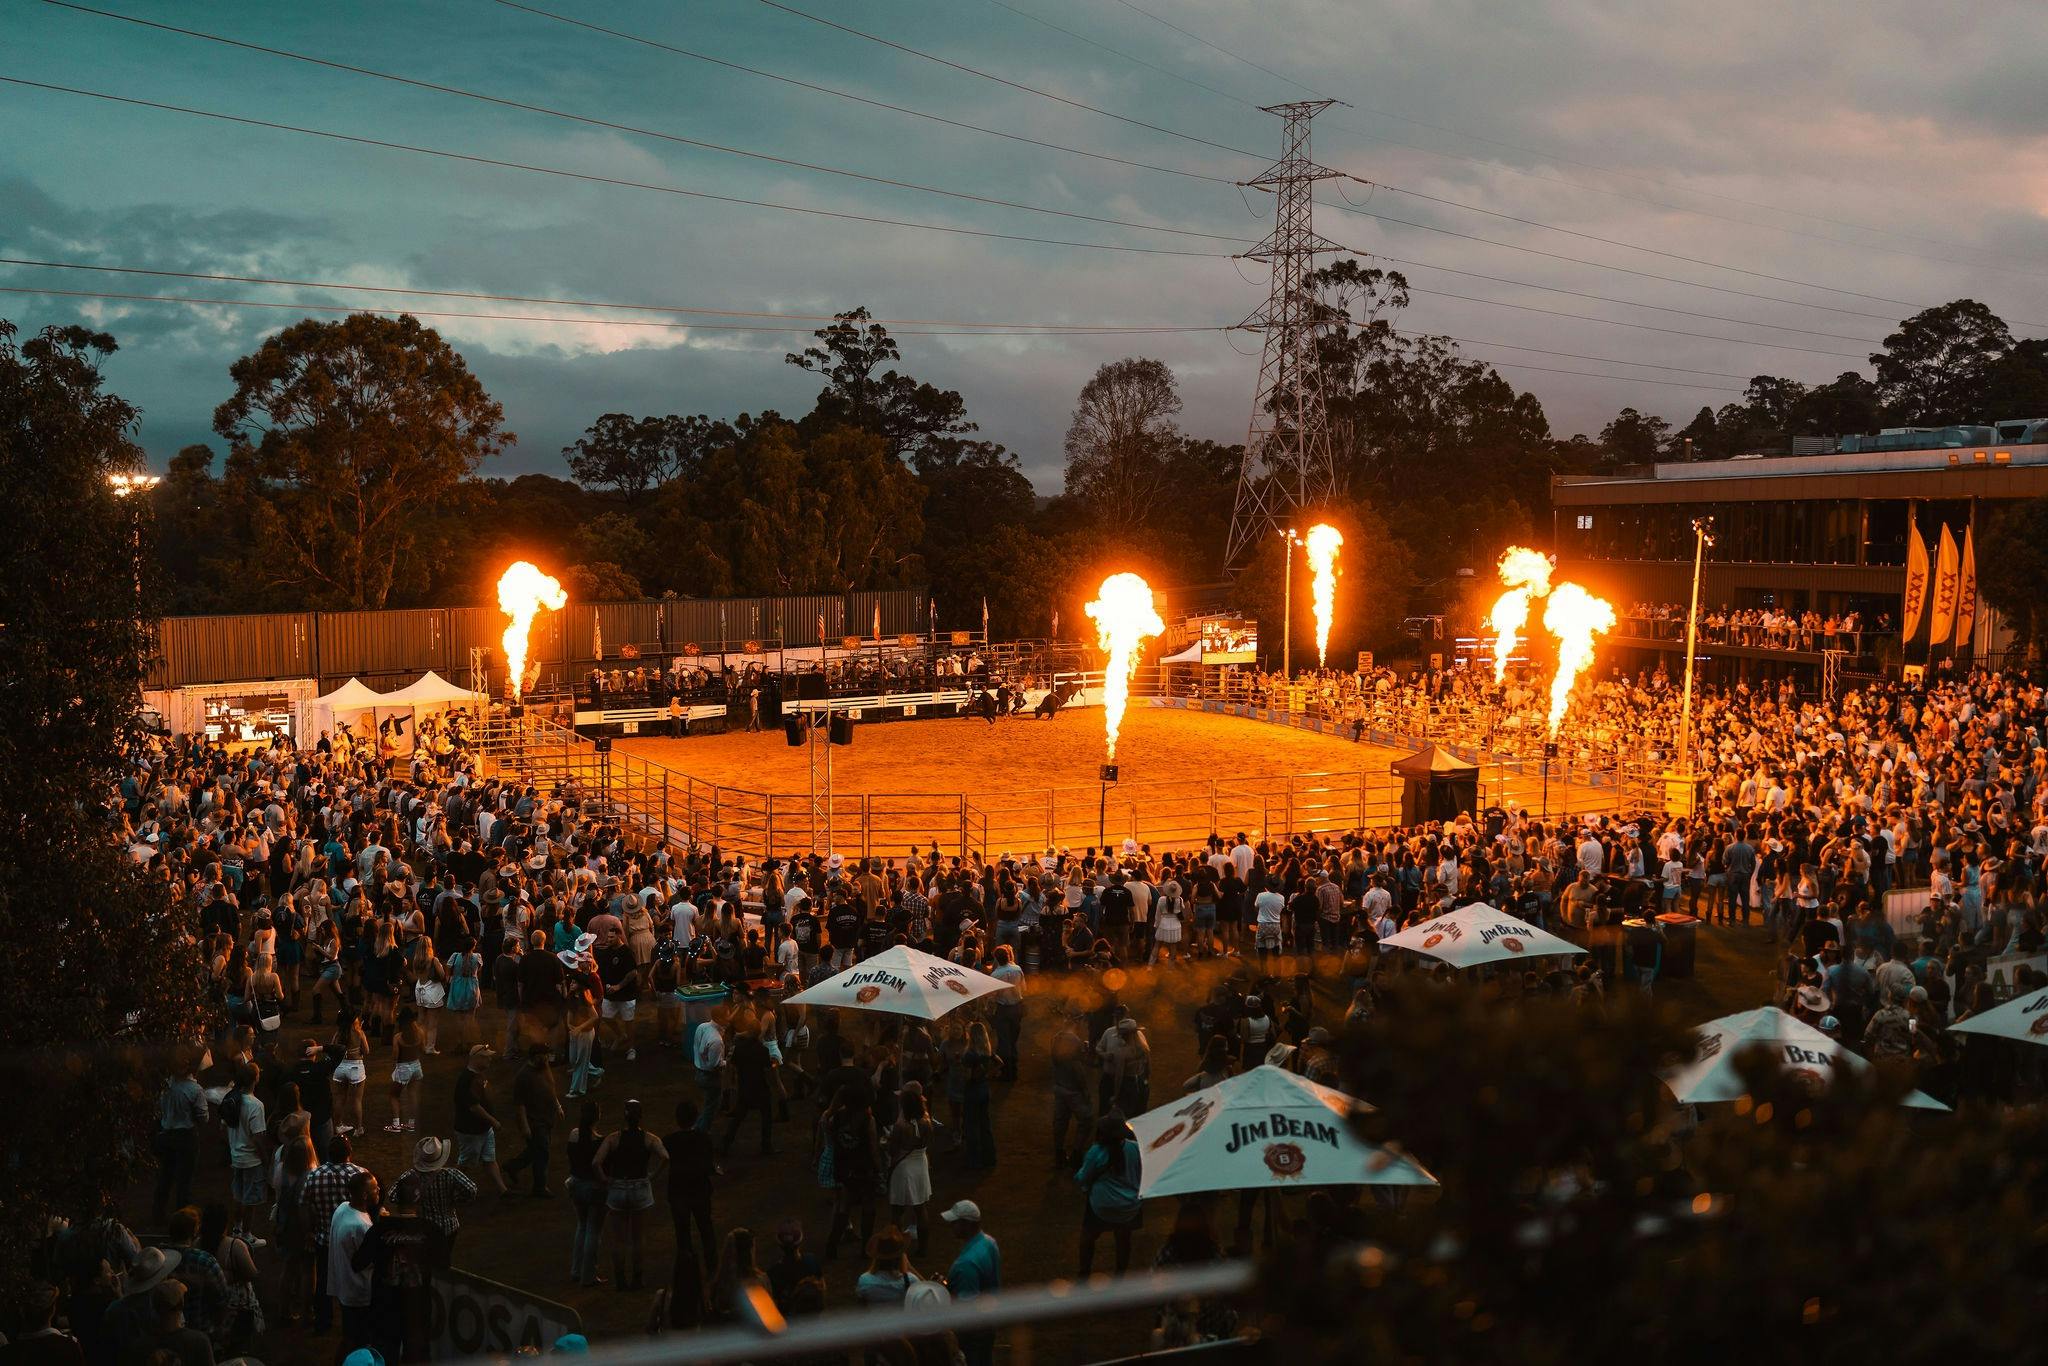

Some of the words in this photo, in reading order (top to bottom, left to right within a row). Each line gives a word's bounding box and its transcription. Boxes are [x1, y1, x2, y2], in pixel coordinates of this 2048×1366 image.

[1906, 571, 1924, 615] XXXX
[1937, 571, 1957, 616] XXXX
[1960, 574, 1975, 617] XXXX
[1423, 922, 1447, 933] JIM
[1443, 922, 1462, 942] BEAM
[1480, 928, 1499, 944] JIM
[1495, 924, 1535, 939] BEAM
[843, 973, 874, 988] JIM
[873, 970, 907, 993] BEAM
[923, 971, 940, 989] JIM
[929, 967, 967, 978] BEAM
[1785, 1045, 1834, 1066] BEA
[1225, 1121, 1269, 1153] JIM
[1270, 1113, 1340, 1150] BEAM
